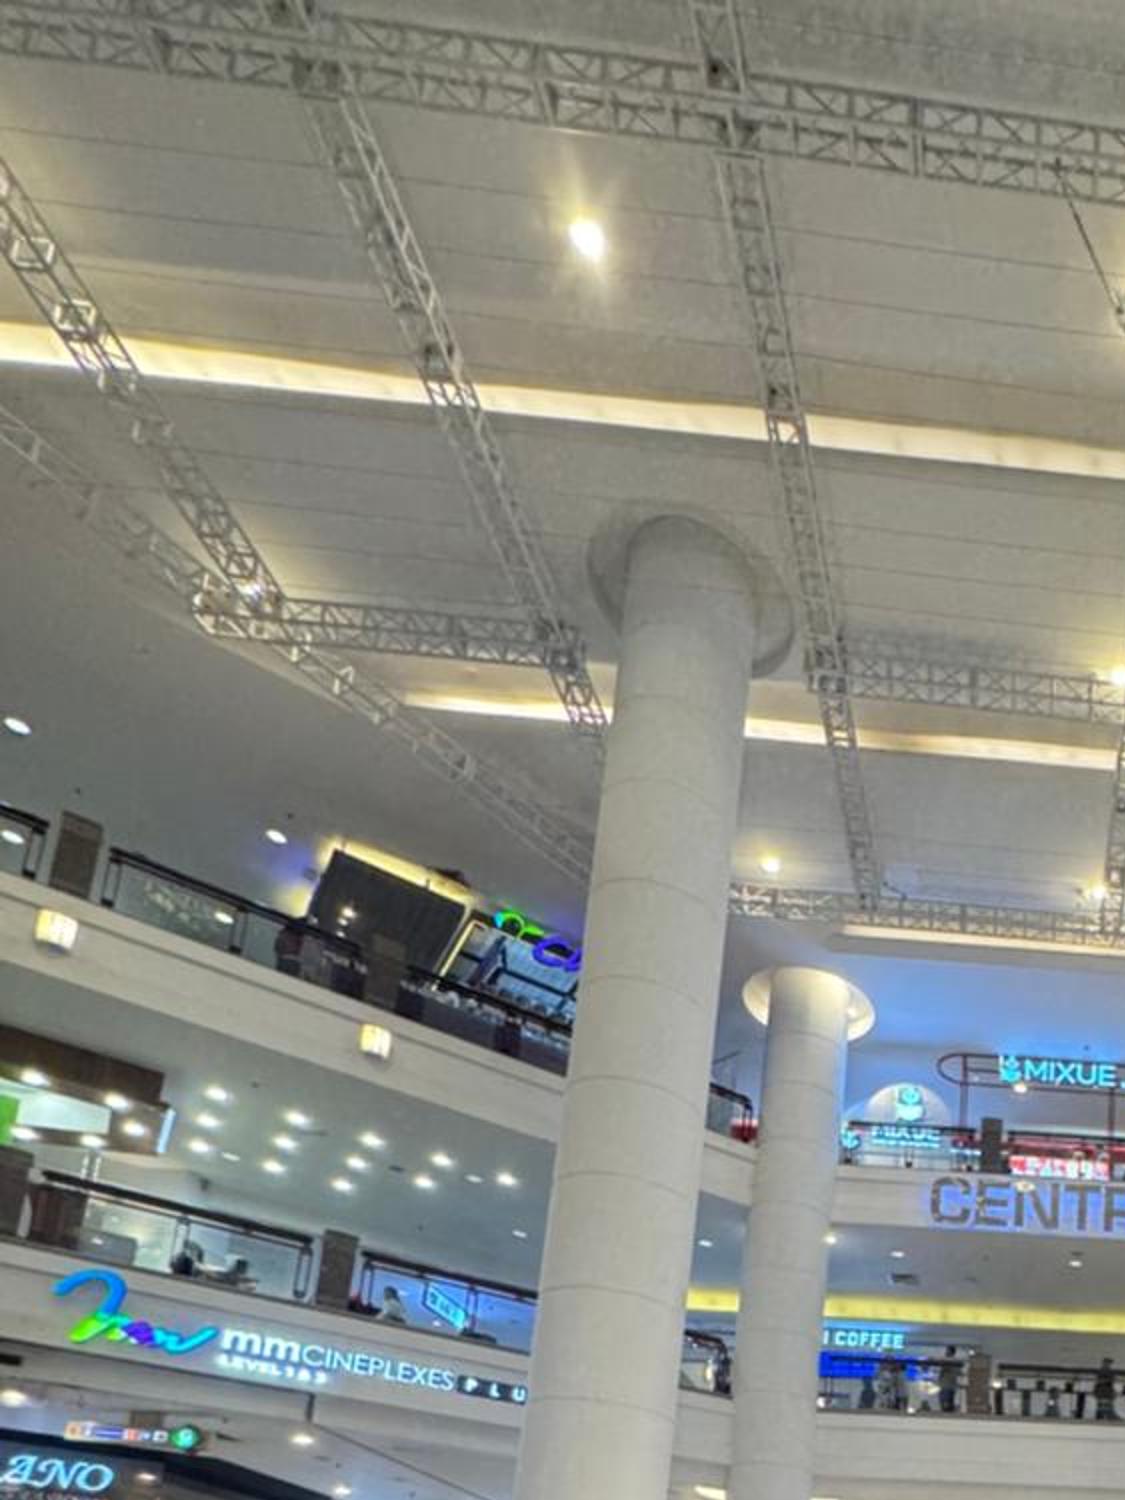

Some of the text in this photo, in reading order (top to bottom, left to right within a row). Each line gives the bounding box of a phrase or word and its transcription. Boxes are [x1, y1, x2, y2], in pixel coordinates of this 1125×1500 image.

[1023, 1058, 1117, 1088] MIXUE
[835, 1330, 905, 1350] COFFEE
[464, 1378, 526, 1402] PLU
